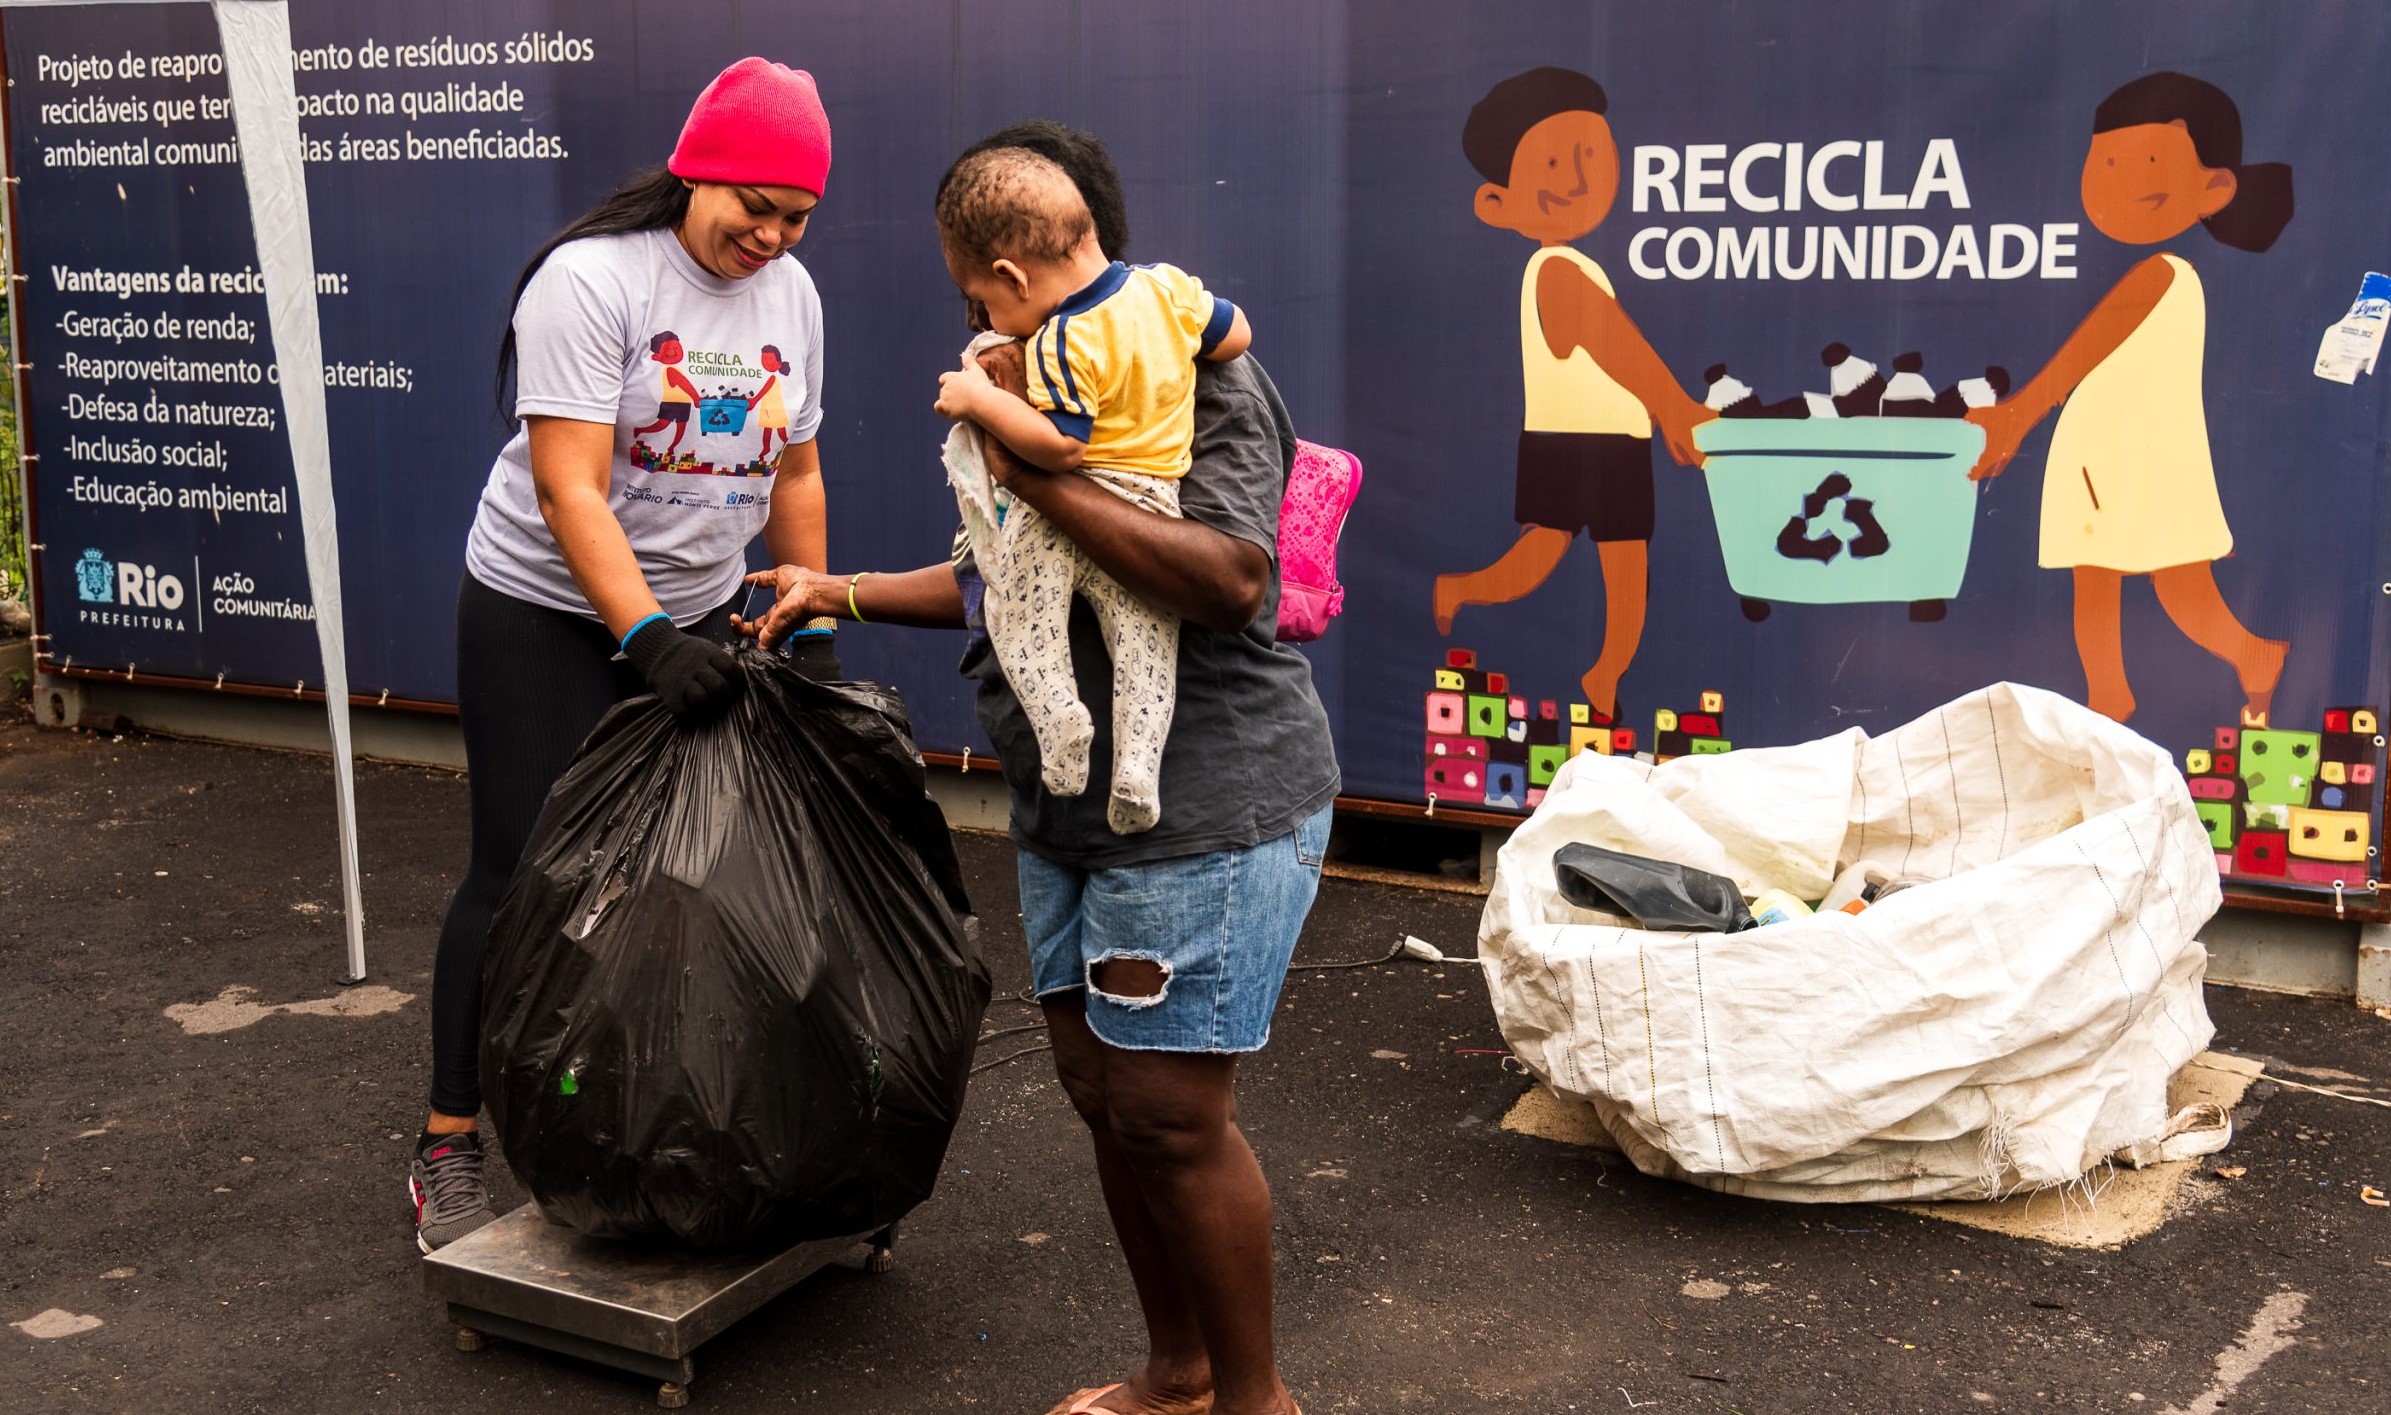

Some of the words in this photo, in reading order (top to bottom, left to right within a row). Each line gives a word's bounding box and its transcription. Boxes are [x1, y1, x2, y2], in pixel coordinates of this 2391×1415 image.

[38, 54, 113, 87] Projeto
[118, 50, 145, 79] de
[151, 44, 352, 83] reaproento
[358, 38, 389, 68] de
[395, 35, 498, 67] resíduos
[504, 31, 594, 64] sólidos
[42, 95, 148, 124] recicláveis
[153, 100, 195, 128] que
[297, 90, 360, 118] pacto
[366, 93, 394, 114] na
[401, 81, 524, 121] qualidade
[44, 137, 149, 166] ambiental
[155, 136, 237, 165] comuni
[339, 132, 400, 161] áreas
[407, 128, 568, 160] beneficiadas.
[1633, 139, 1971, 212] RECICLA
[1628, 223, 2079, 280] COMUNIDADE
[52, 266, 170, 299] Vantagens
[176, 265, 204, 293] da
[210, 266, 349, 295] recicm:
[56, 311, 148, 344] -Geração
[154, 311, 181, 339] de
[187, 312, 255, 344] renda;
[59, 352, 261, 385] -Reaproveitamento
[324, 360, 412, 394] ateriais;
[688, 351, 743, 366] RECICLA
[688, 365, 763, 379] COMUNIDADE
[62, 394, 138, 421] -Defesa
[144, 392, 169, 423] da
[176, 401, 275, 431] natureza;
[64, 435, 156, 464] -Inclusão
[162, 441, 227, 471] social;
[67, 476, 172, 512] -Educação
[179, 484, 286, 514] ambiental
[737, 493, 755, 505] Rio
[118, 562, 183, 609] Rio
[213, 572, 254, 595] AÇÃO
[81, 608, 184, 630] PREFEITURA
[213, 598, 316, 621] COMUNITÁRIA
